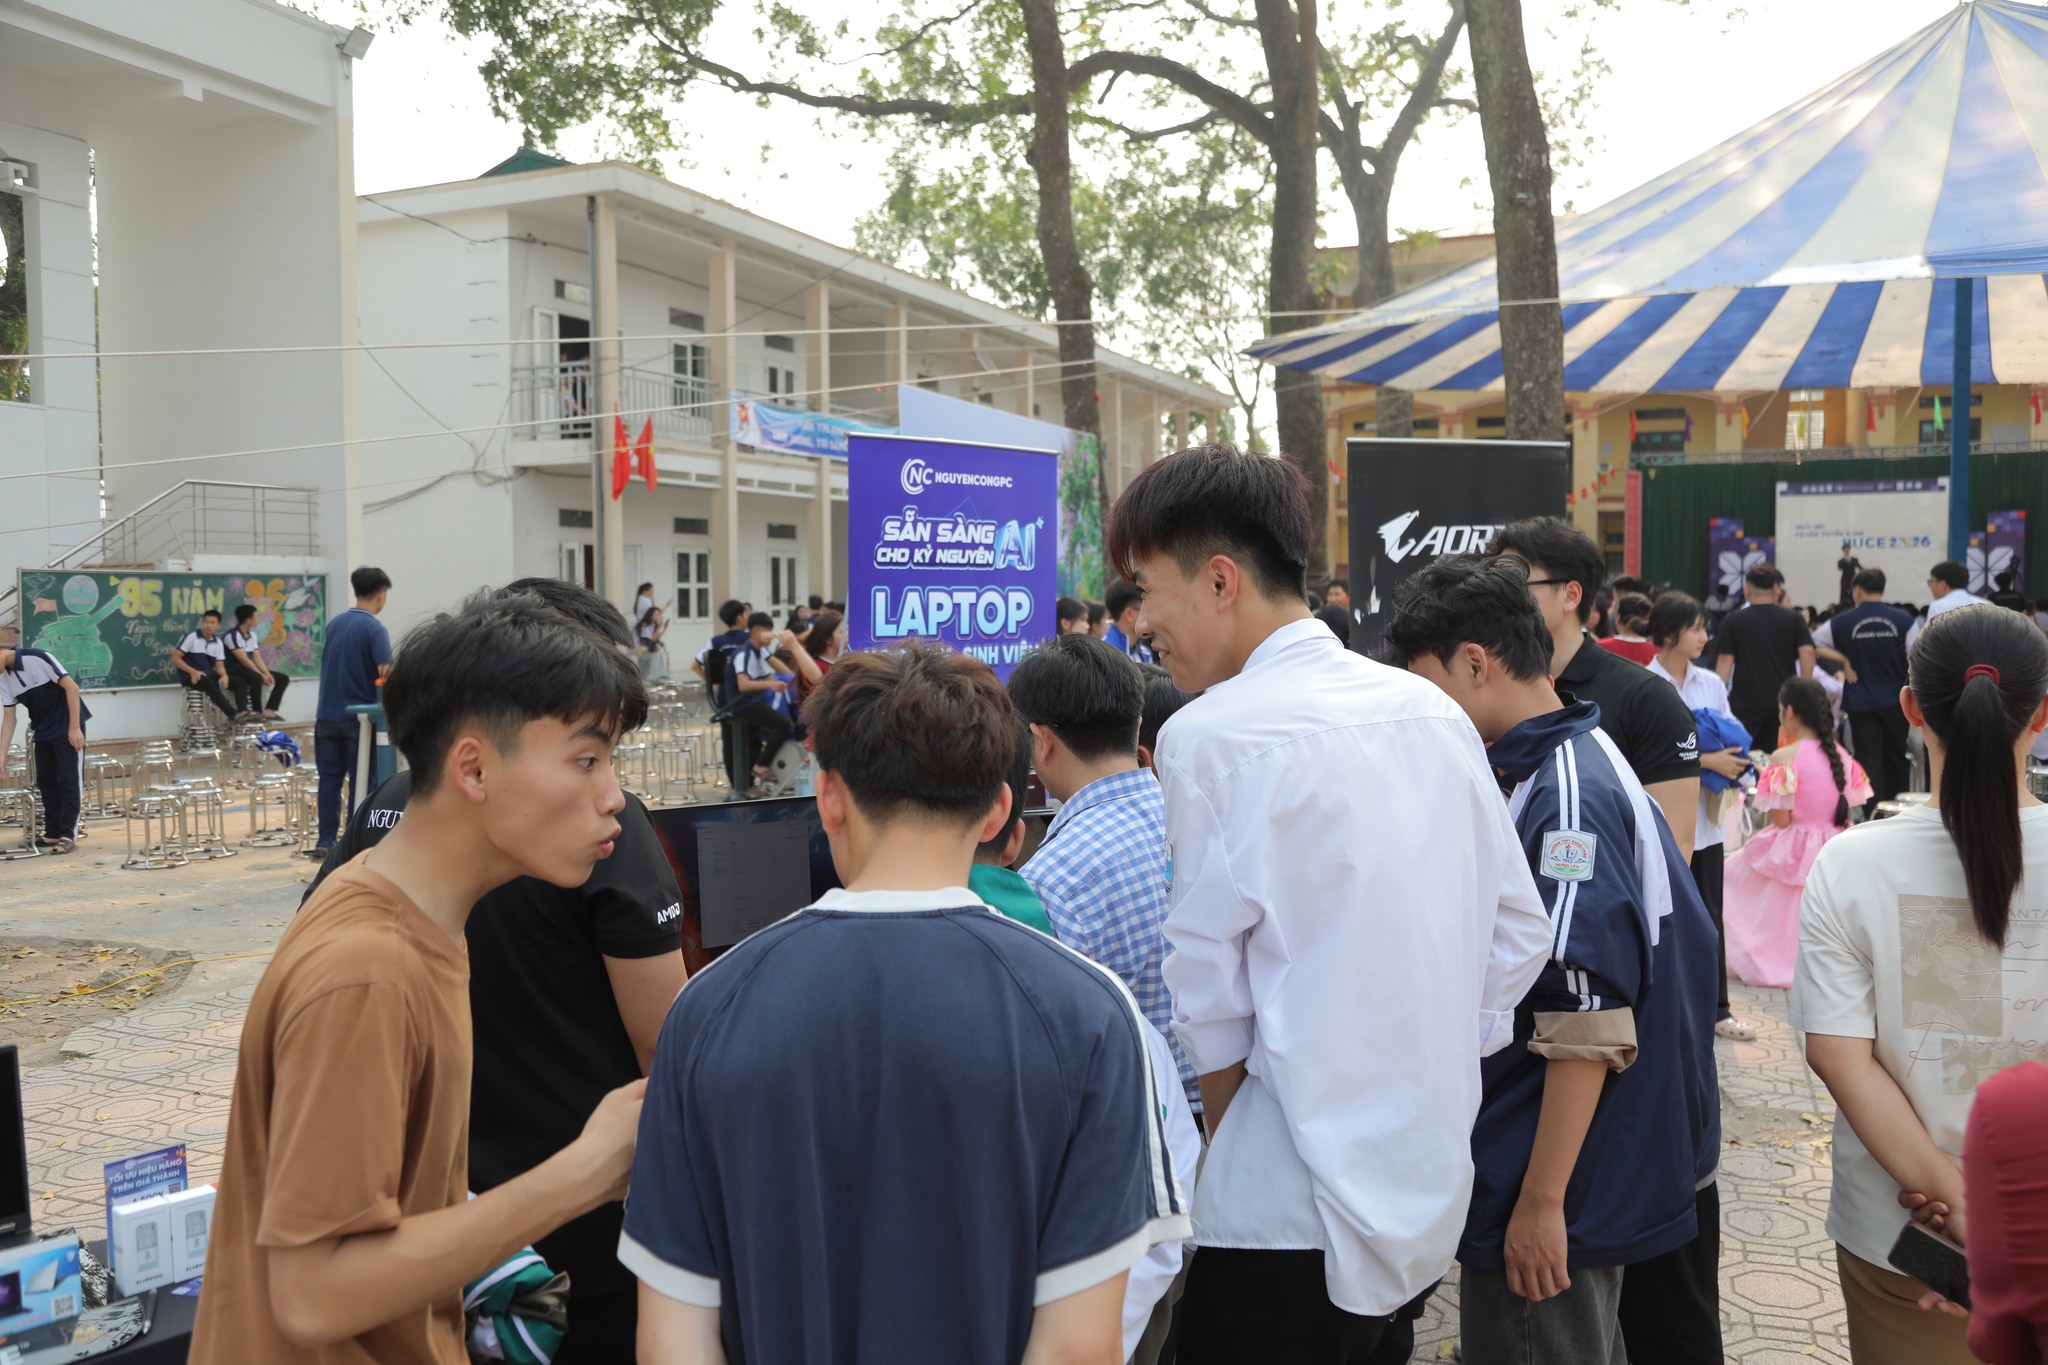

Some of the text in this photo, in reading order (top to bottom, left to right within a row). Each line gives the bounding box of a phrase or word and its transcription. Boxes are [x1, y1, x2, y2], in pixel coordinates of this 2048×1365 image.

[935, 472, 1013, 488] NGUYENCONGPC
[883, 510, 996, 545] SẴN SÀNG
[1411, 525, 1505, 556] AOR
[876, 520, 1036, 571] CHO KỶ NGUYÊN AI
[118, 577, 225, 617] 95 NĂM
[874, 590, 1031, 638] LAPTOP
[963, 646, 999, 665] SINH
